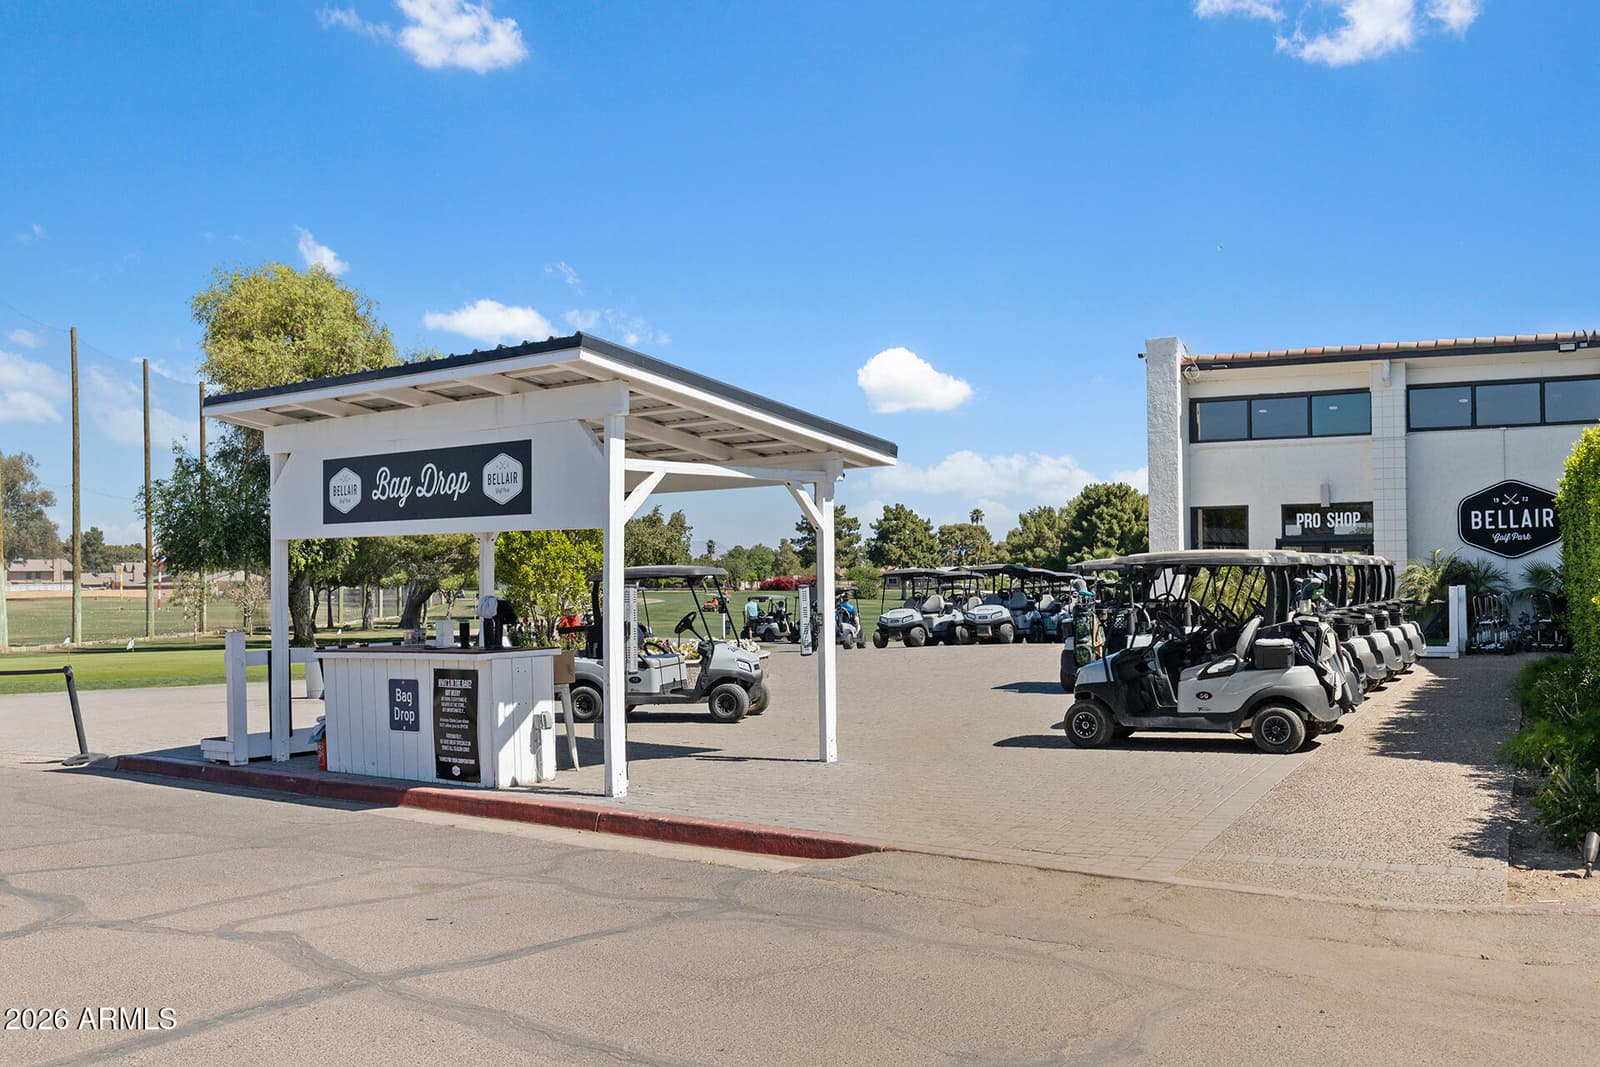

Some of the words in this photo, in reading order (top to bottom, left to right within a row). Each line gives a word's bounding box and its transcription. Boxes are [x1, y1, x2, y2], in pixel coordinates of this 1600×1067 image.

[372, 466, 413, 508] Bag
[415, 463, 471, 501] Drop
[487, 472, 518, 486] BELLAIR
[333, 484, 358, 497] BELLAIR
[1296, 513, 1321, 528] PRO
[1327, 512, 1361, 528] SHOP
[1470, 508, 1554, 530] BELLAIR
[1492, 532, 1511, 544] Golf
[1511, 532, 1532, 541] Park
[395, 688, 412, 706] Bag
[394, 707, 415, 724] Drop
